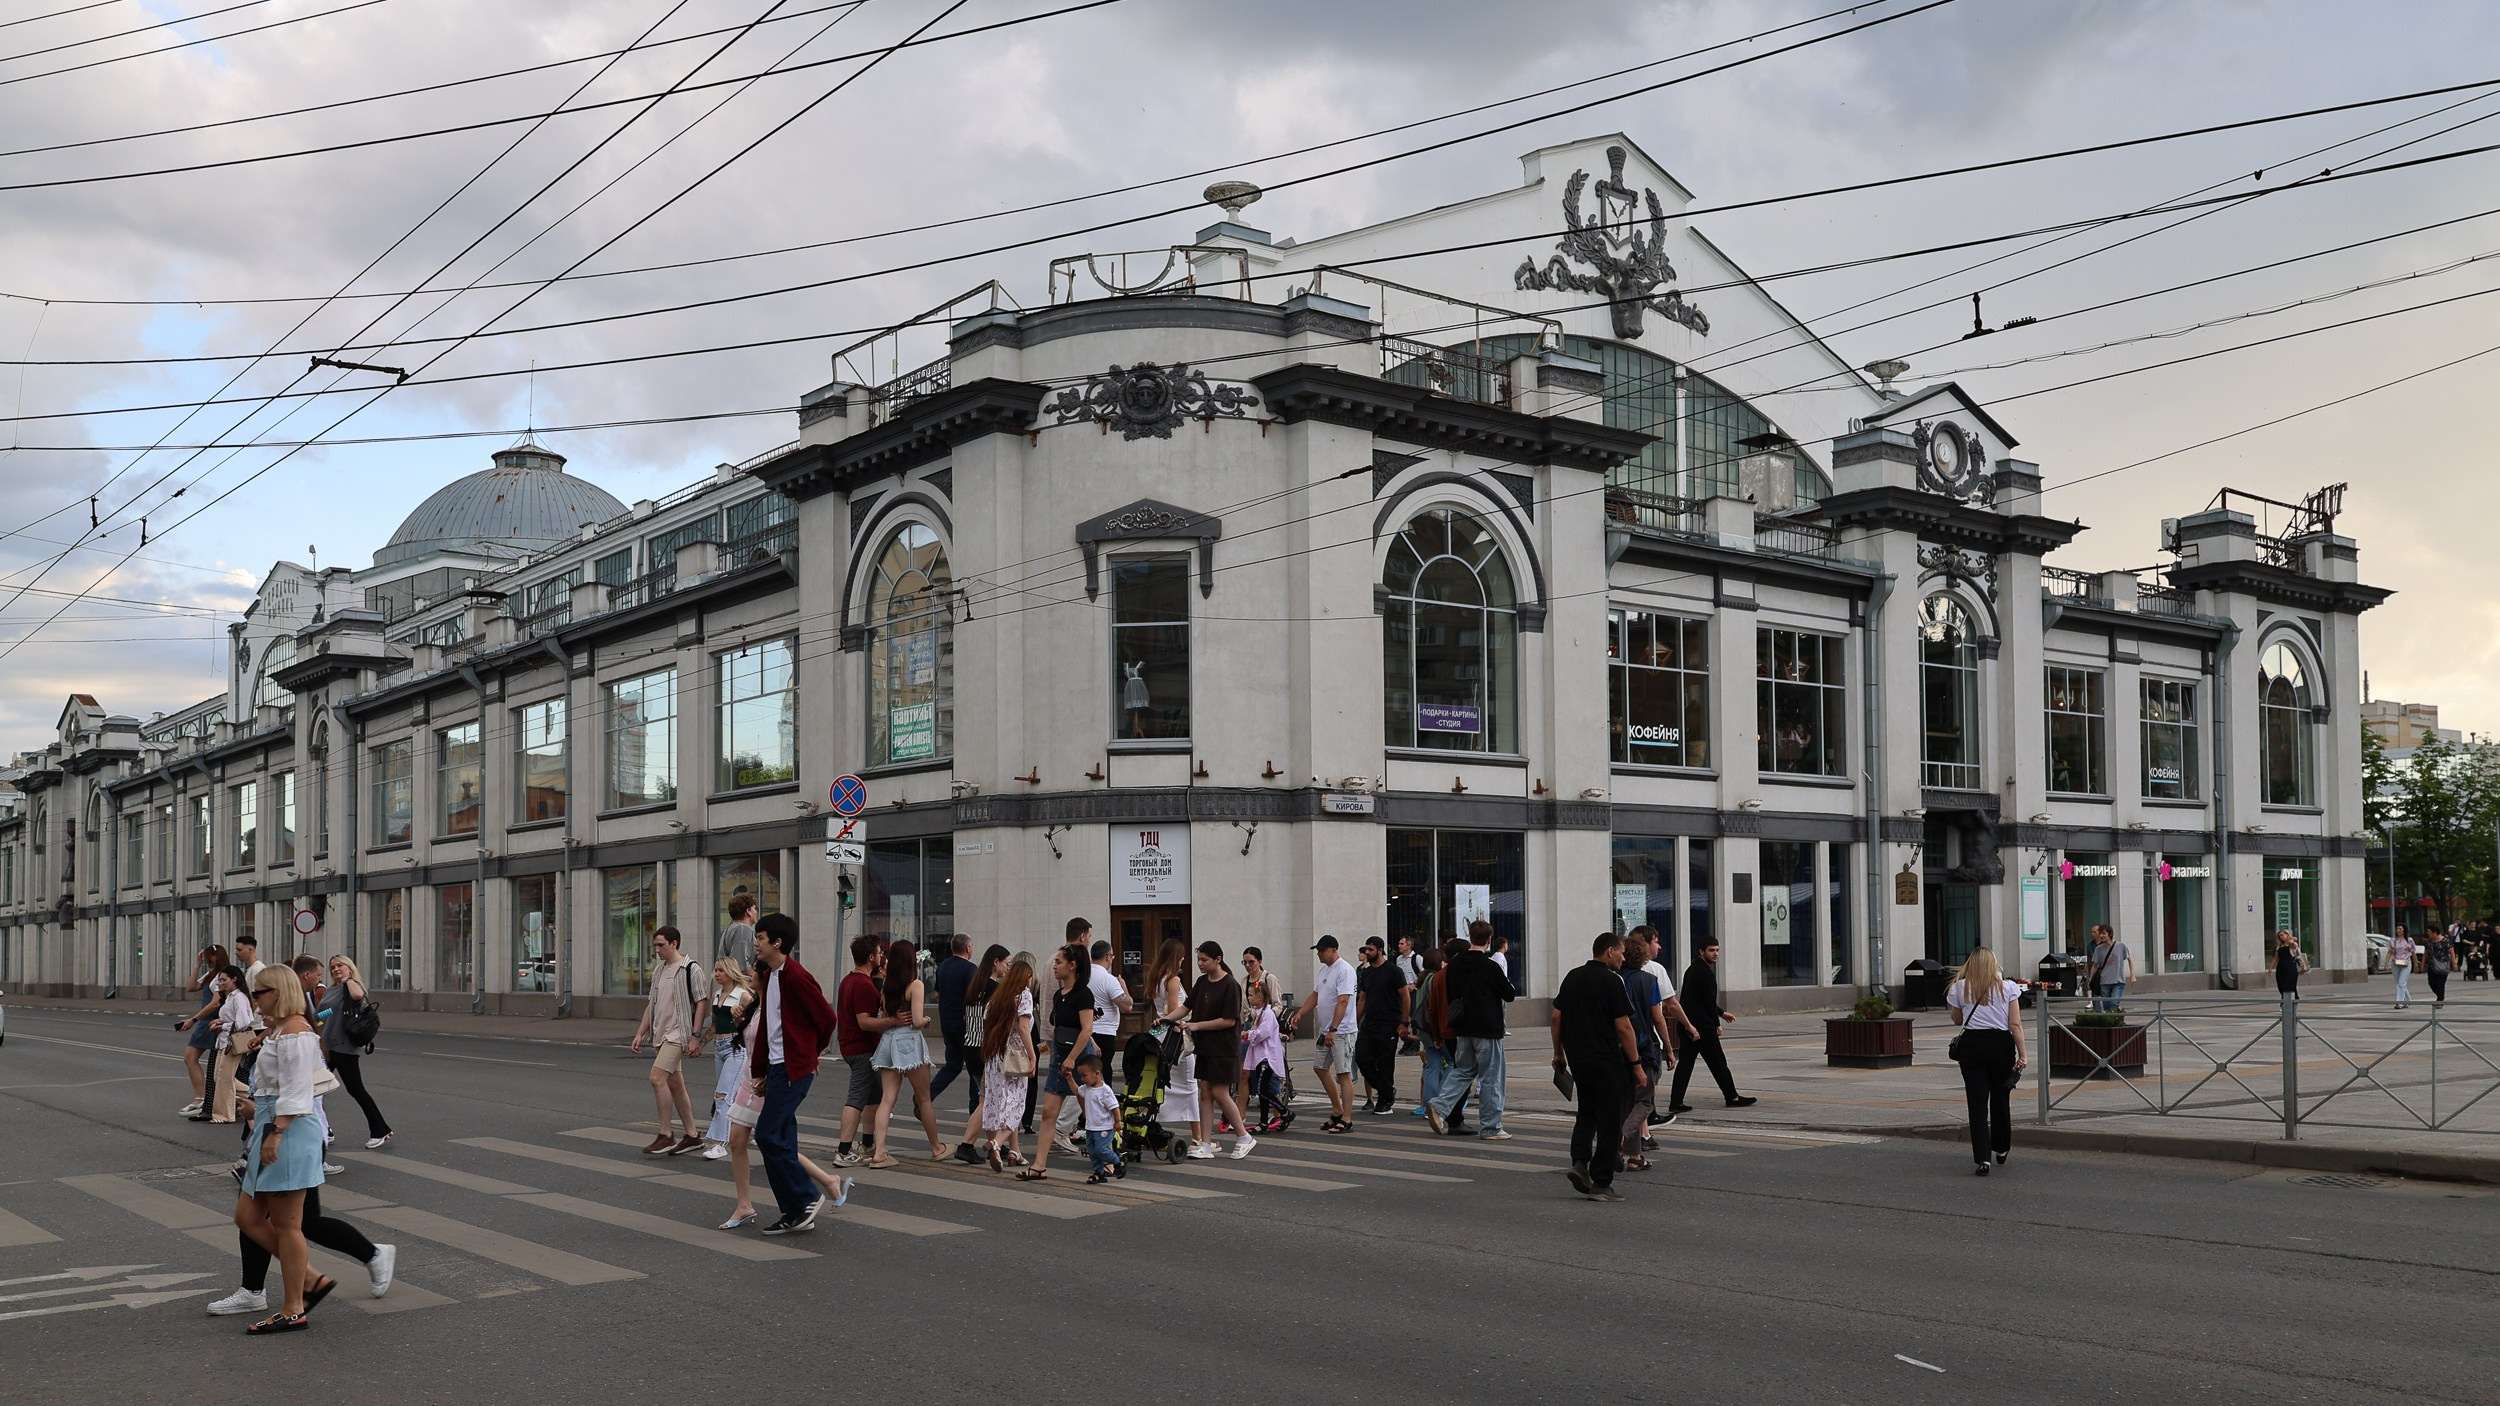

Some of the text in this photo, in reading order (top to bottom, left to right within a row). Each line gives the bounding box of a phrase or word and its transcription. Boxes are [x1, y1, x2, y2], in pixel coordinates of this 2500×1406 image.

[1422, 709, 1477, 719] ПОДАРКИ КАРТИНЫ
[1438, 719, 1461, 727] СТУДИЯ
[1629, 724, 1679, 741] КОФЕЙНЯ
[1335, 802, 1364, 811] КИРОВА
[1140, 831, 1160, 849] ТДЦ
[1129, 858, 1172, 867] ТОРГОВЫЙ ДОМ
[1129, 867, 1172, 876] ЦЕНТРАЛЬНЫЙ
[2074, 865, 2117, 876] малина
[2172, 866, 2210, 877] малина
[2281, 868, 2303, 880] ДУБКИ
